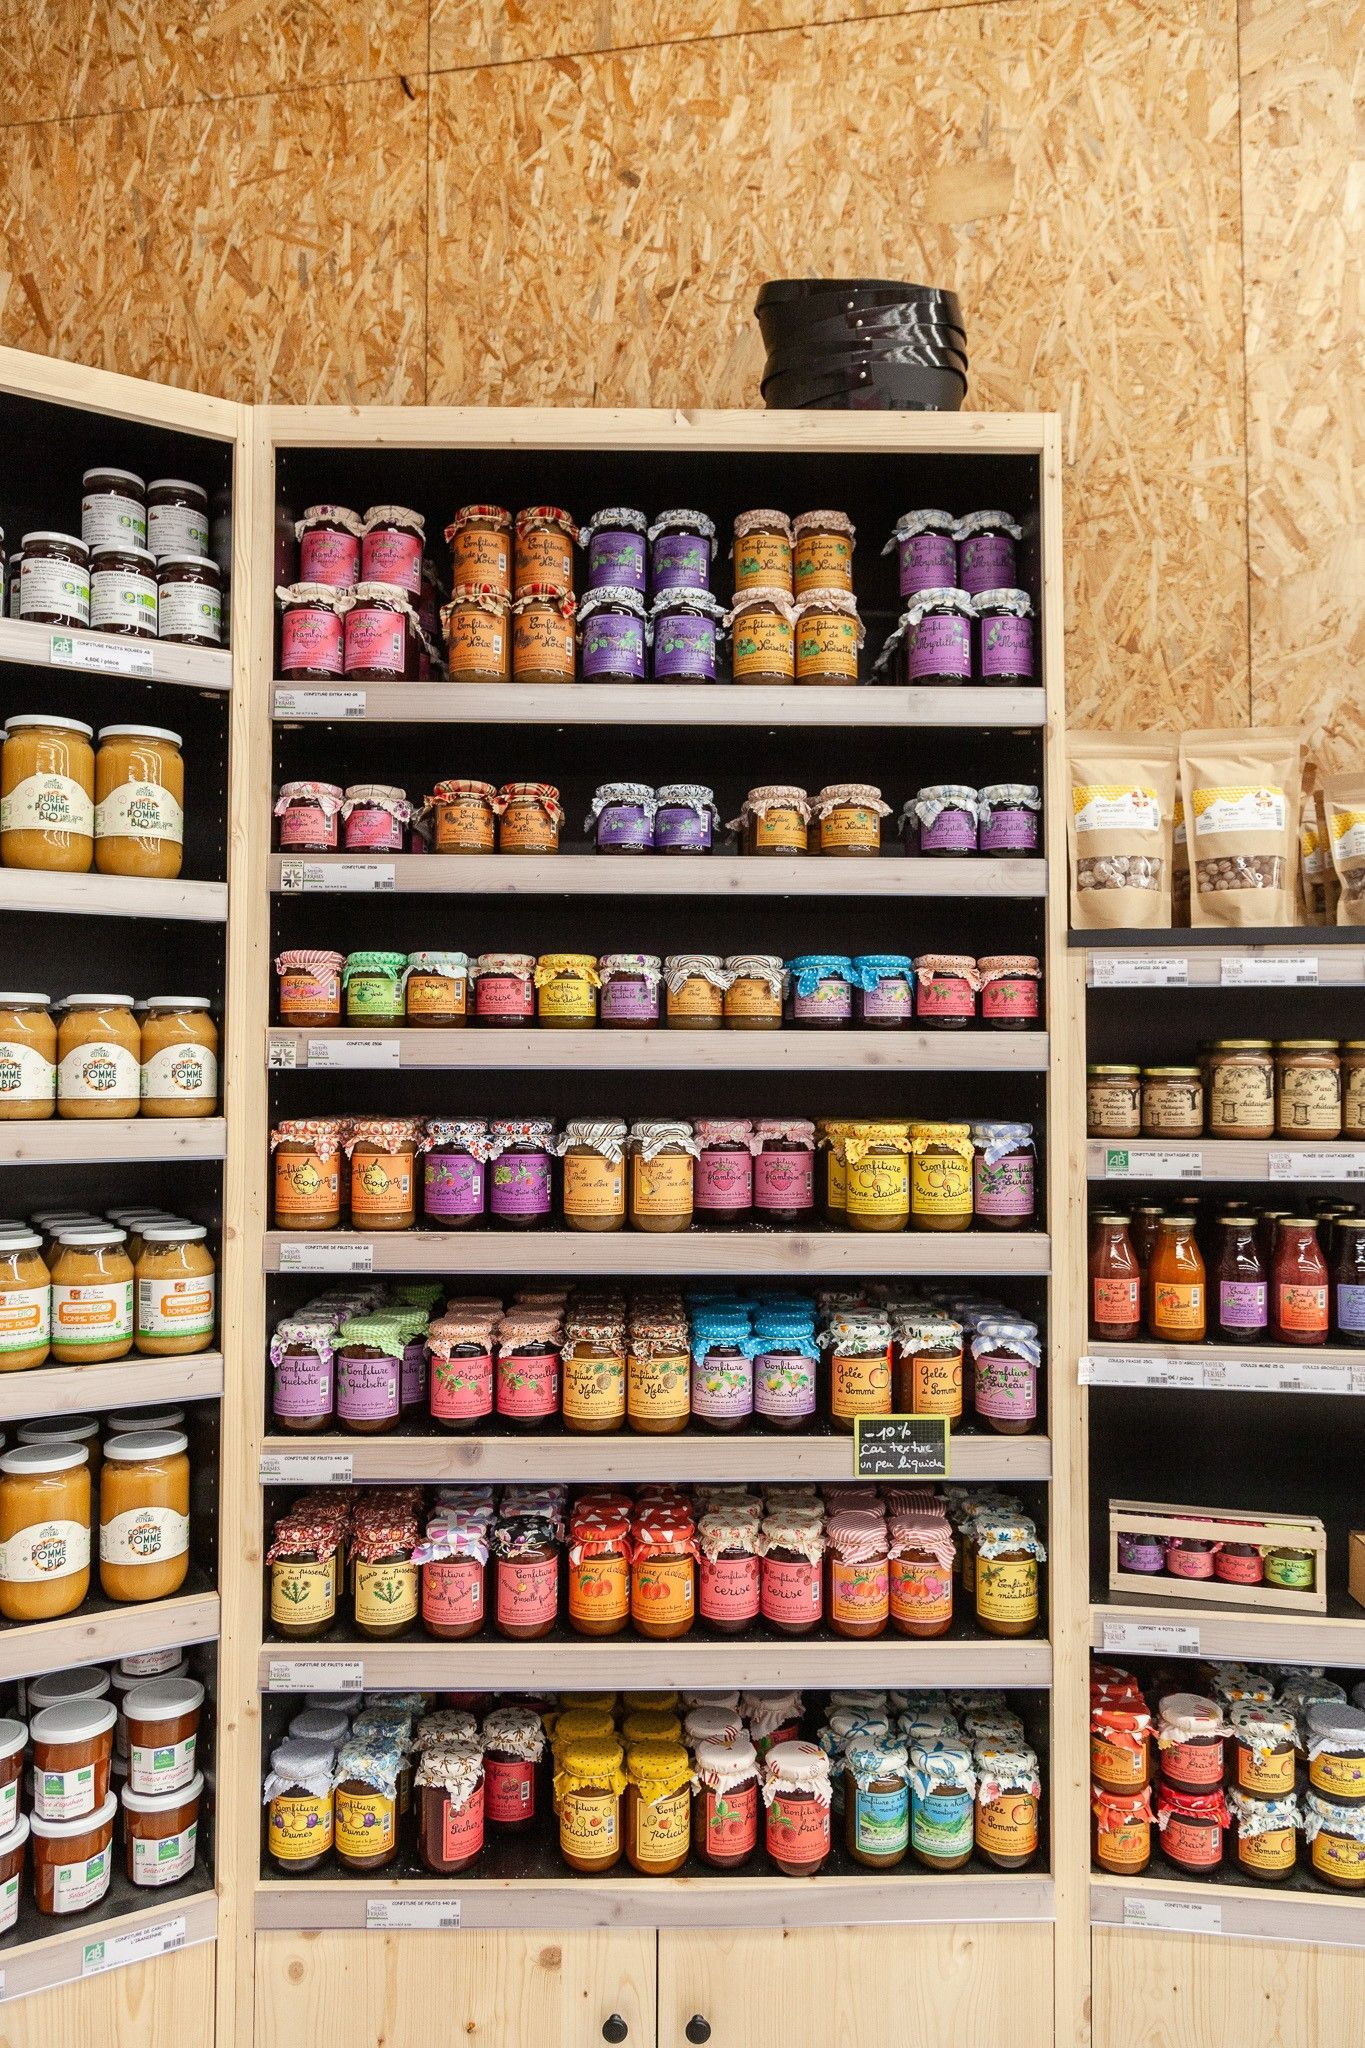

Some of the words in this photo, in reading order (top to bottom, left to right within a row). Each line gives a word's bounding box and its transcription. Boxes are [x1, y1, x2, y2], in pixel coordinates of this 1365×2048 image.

[463, 535, 499, 554] Confiture
[528, 536, 564, 554] Confiture
[741, 540, 778, 554] Confiture
[457, 616, 494, 634] Confiture
[529, 616, 567, 635] Confiture
[739, 618, 777, 635] Confiture
[801, 618, 840, 636] Confiture
[34, 802, 70, 814] POMME
[127, 809, 161, 820] POMME
[38, 812, 59, 821] BIO
[130, 819, 150, 828] BIO
[83, 1069, 117, 1079] POMME
[171, 1069, 203, 1079] POMME
[98, 1079, 117, 1088] BIO
[186, 1079, 203, 1088] BIO
[853, 1160, 902, 1178] Confiture
[918, 1160, 969, 1176] Confiture
[293, 1174, 333, 1188] Coing
[363, 1174, 401, 1189] Coing
[280, 1360, 321, 1378] Confiture
[347, 1364, 389, 1381] Confiture
[630, 1366, 659, 1384] Confiture
[703, 1360, 744, 1376] Confiture
[764, 1359, 804, 1376] Confiture
[837, 1364, 864, 1383] Gelée
[920, 1364, 949, 1383] Gelée
[280, 1374, 319, 1390] Quetsche
[565, 1366, 593, 1385] Confiture
[348, 1379, 388, 1394] Quetsche
[578, 1382, 604, 1400] Melon
[644, 1382, 670, 1399] Melon
[846, 1383, 876, 1396] Pomme
[930, 1383, 957, 1396] Pomme
[989, 1378, 1025, 1390] Sureau
[889, 1440, 934, 1455] texture
[860, 1461, 872, 1469] un
[875, 1461, 894, 1473] peu
[897, 1455, 946, 1473] liquide
[128, 1526, 162, 1536] COMPOTE
[31, 1540, 67, 1552] COMPOTE
[128, 1534, 162, 1545] POMME
[31, 1549, 67, 1560] POMME
[142, 1543, 162, 1553] BIO
[47, 1556, 67, 1568] BIO
[428, 1566, 466, 1580] Confiture
[714, 1583, 751, 1595] cerise
[767, 1586, 805, 1598] cerise
[985, 1589, 993, 1597] de
[997, 1578, 1030, 1593] Confiture
[275, 1802, 319, 1818] Confiture
[988, 1815, 1019, 1833] Pomme
[281, 1828, 313, 1839] Prunes
[342, 1827, 370, 1838] Prunes
